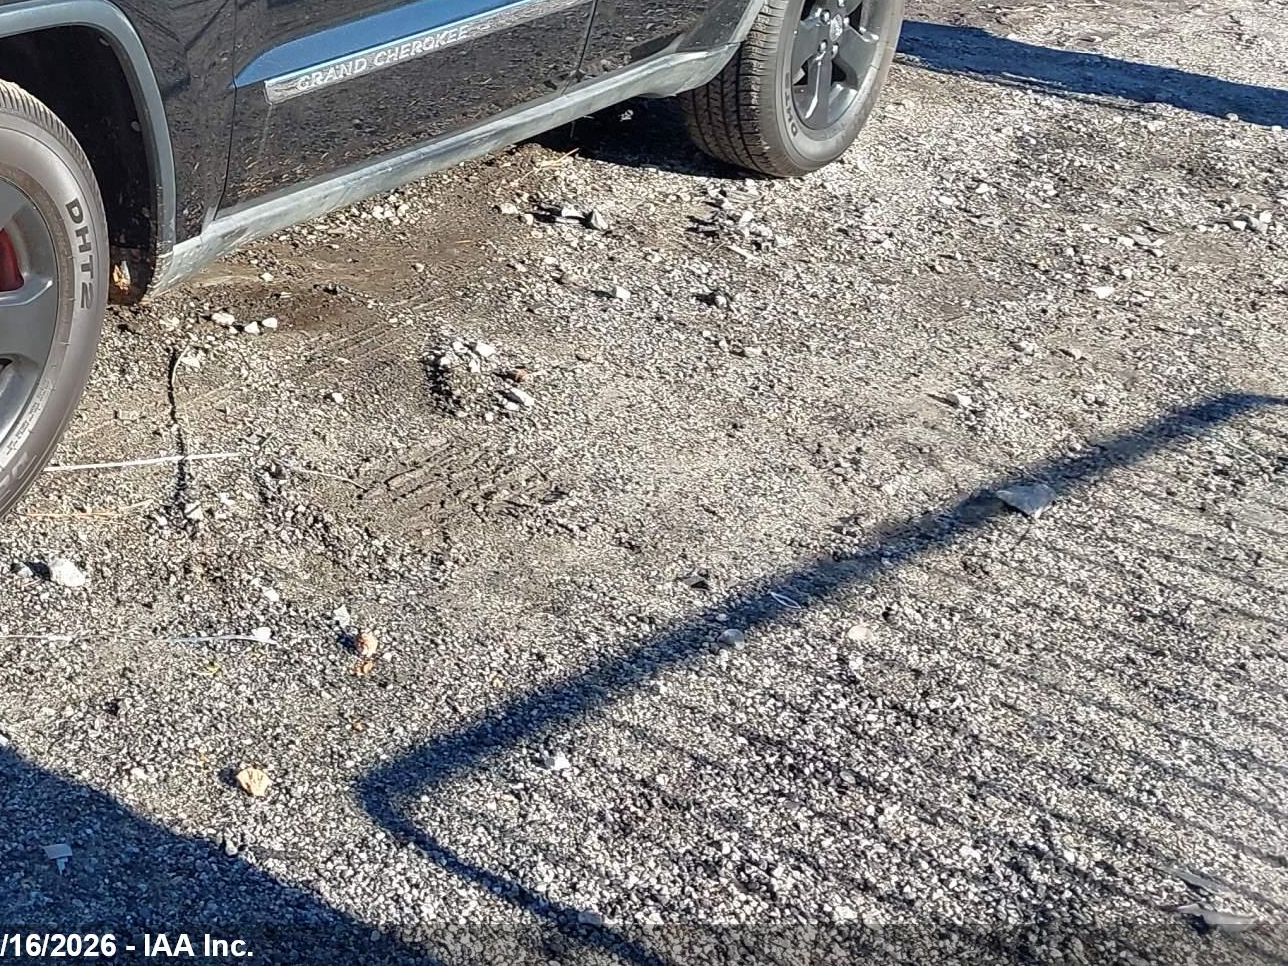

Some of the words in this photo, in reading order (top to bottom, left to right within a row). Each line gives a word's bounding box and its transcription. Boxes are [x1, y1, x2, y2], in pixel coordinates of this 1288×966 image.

[295, 56, 368, 91] GRAND
[373, 24, 470, 68] CHEROKEE
[65, 197, 95, 310] DHT2
